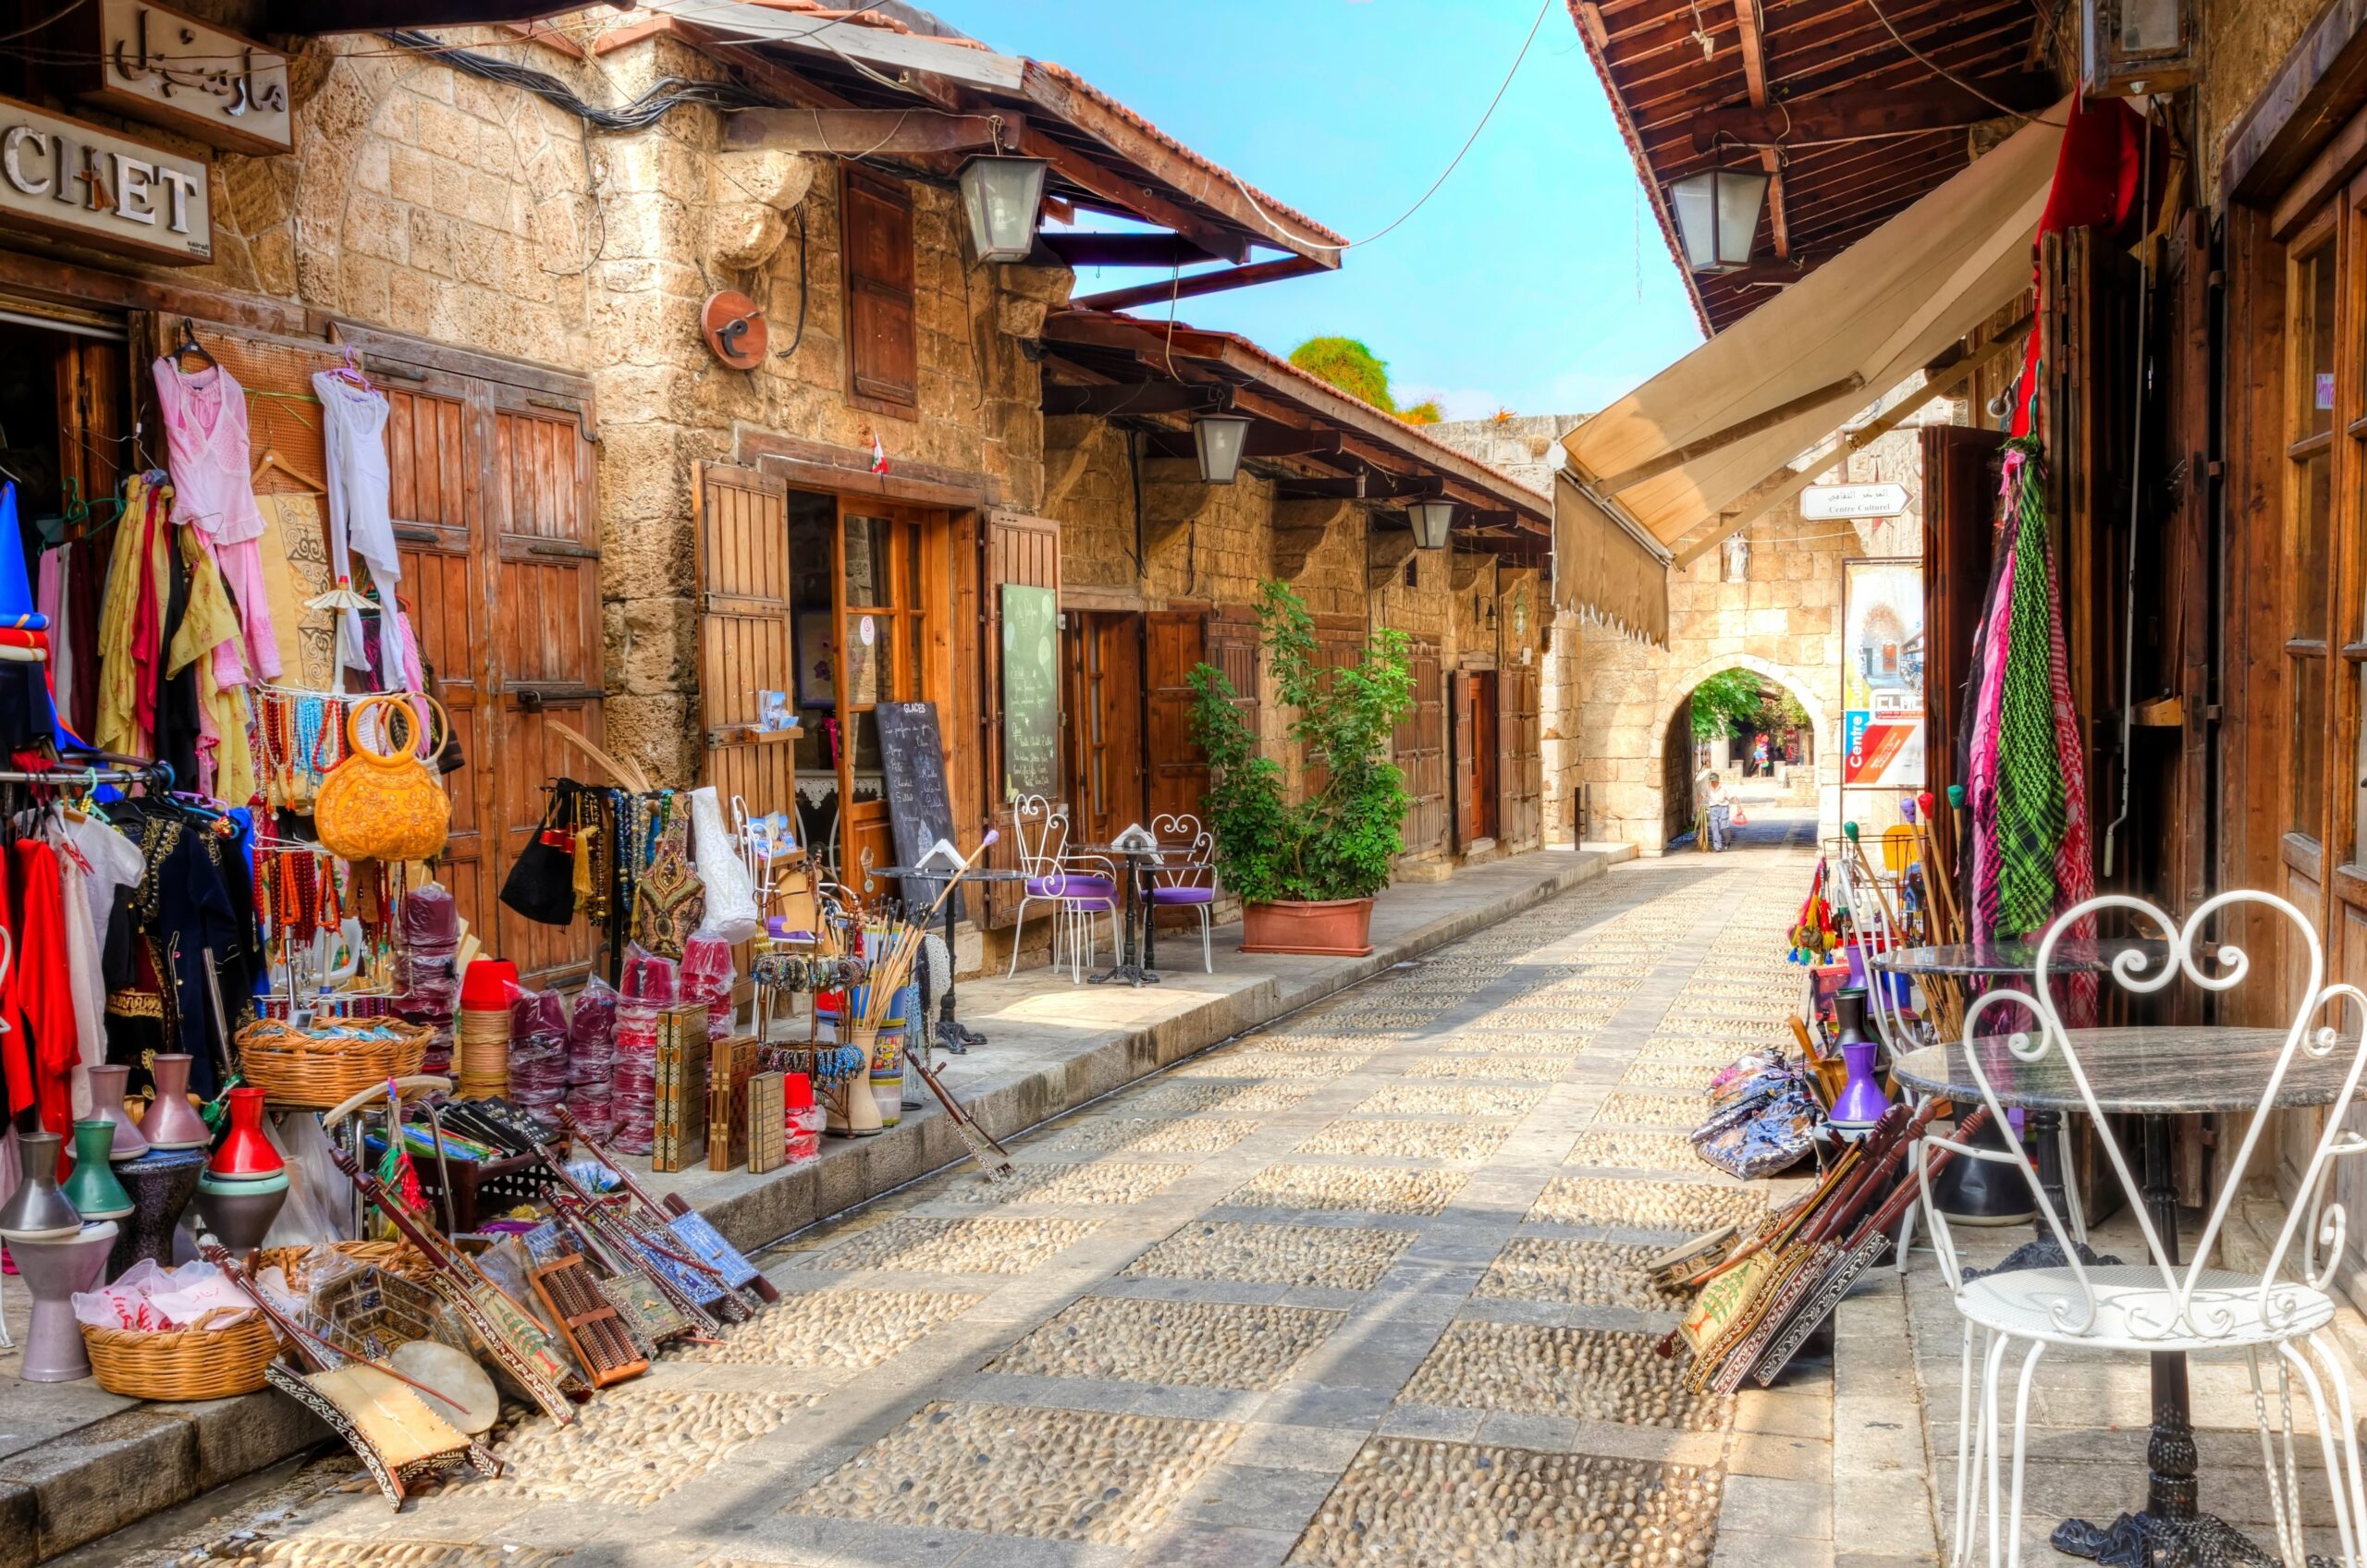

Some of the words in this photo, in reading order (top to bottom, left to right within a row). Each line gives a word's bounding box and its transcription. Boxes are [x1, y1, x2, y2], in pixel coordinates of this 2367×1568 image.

[1, 126, 198, 234] CHET
[1858, 504, 1890, 512] Culturel
[903, 703, 926, 714] GLACES
[1850, 715, 1863, 768] Centre
